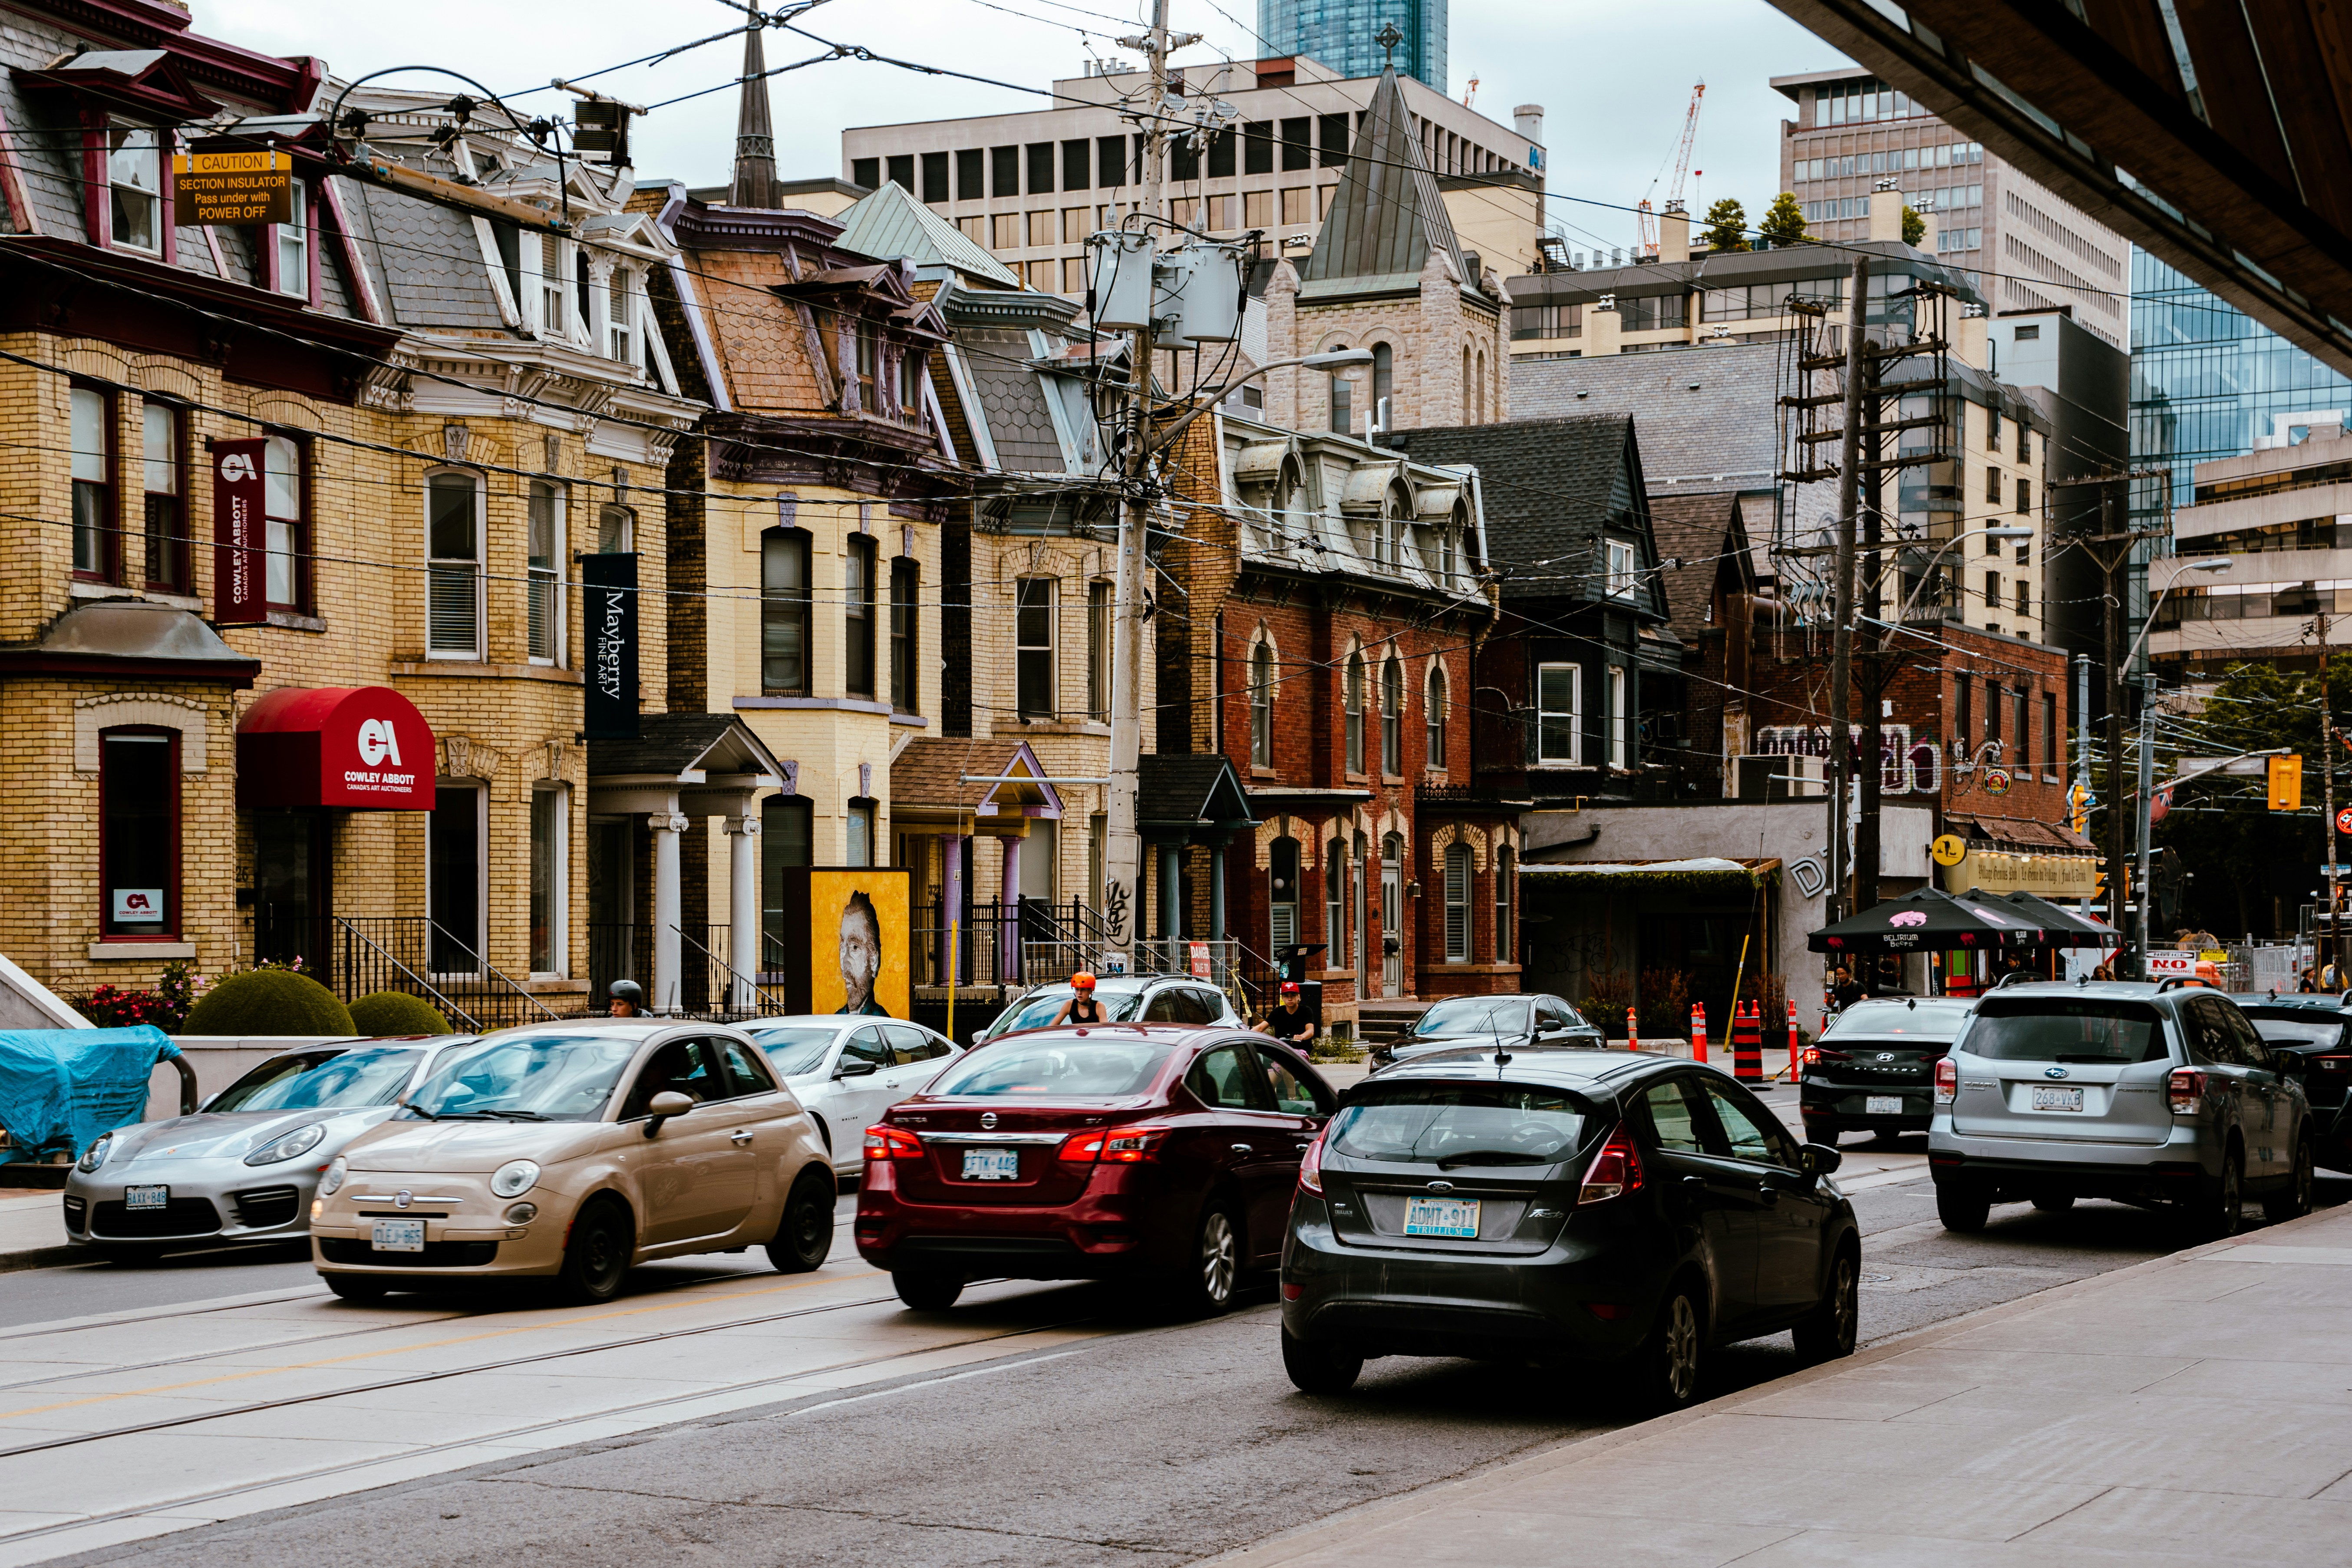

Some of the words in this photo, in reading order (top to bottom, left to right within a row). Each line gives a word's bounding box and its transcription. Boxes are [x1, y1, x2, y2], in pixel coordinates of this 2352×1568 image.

[202, 155, 262, 170] CAUTION
[179, 178, 225, 190] SECTION
[228, 176, 285, 188] INSULATOR
[195, 193, 218, 204] Pass
[220, 192, 248, 203] under
[251, 191, 270, 202] with
[199, 207, 241, 219] POWER
[243, 206, 266, 218] OFF
[232, 495, 241, 547] ABBOTT
[232, 549, 242, 604] COWLEY
[598, 637, 607, 661] FINE
[601, 591, 625, 700] Mayberry
[598, 664, 607, 685] ART
[344, 771, 380, 783] COWLEY
[382, 773, 415, 785] ABBOTT
[1978, 864, 1992, 882] Village
[1993, 865, 2008, 880] Genius
[2021, 866, 2027, 881] Le
[2044, 867, 2058, 885] Village
[2062, 868, 2071, 885] Food
[1190, 946, 1210, 959] DANGER
[1195, 963, 1204, 973] DUE
[1204, 964, 1209, 973] TO
[2152, 959, 2187, 969] NO
[2036, 1092, 2055, 1105] 268
[2061, 1093, 2081, 1106] VKB
[1409, 1206, 1442, 1225] ADHT
[1450, 1208, 1474, 1228] 911
[1415, 1226, 1463, 1235] TRILLIUM
